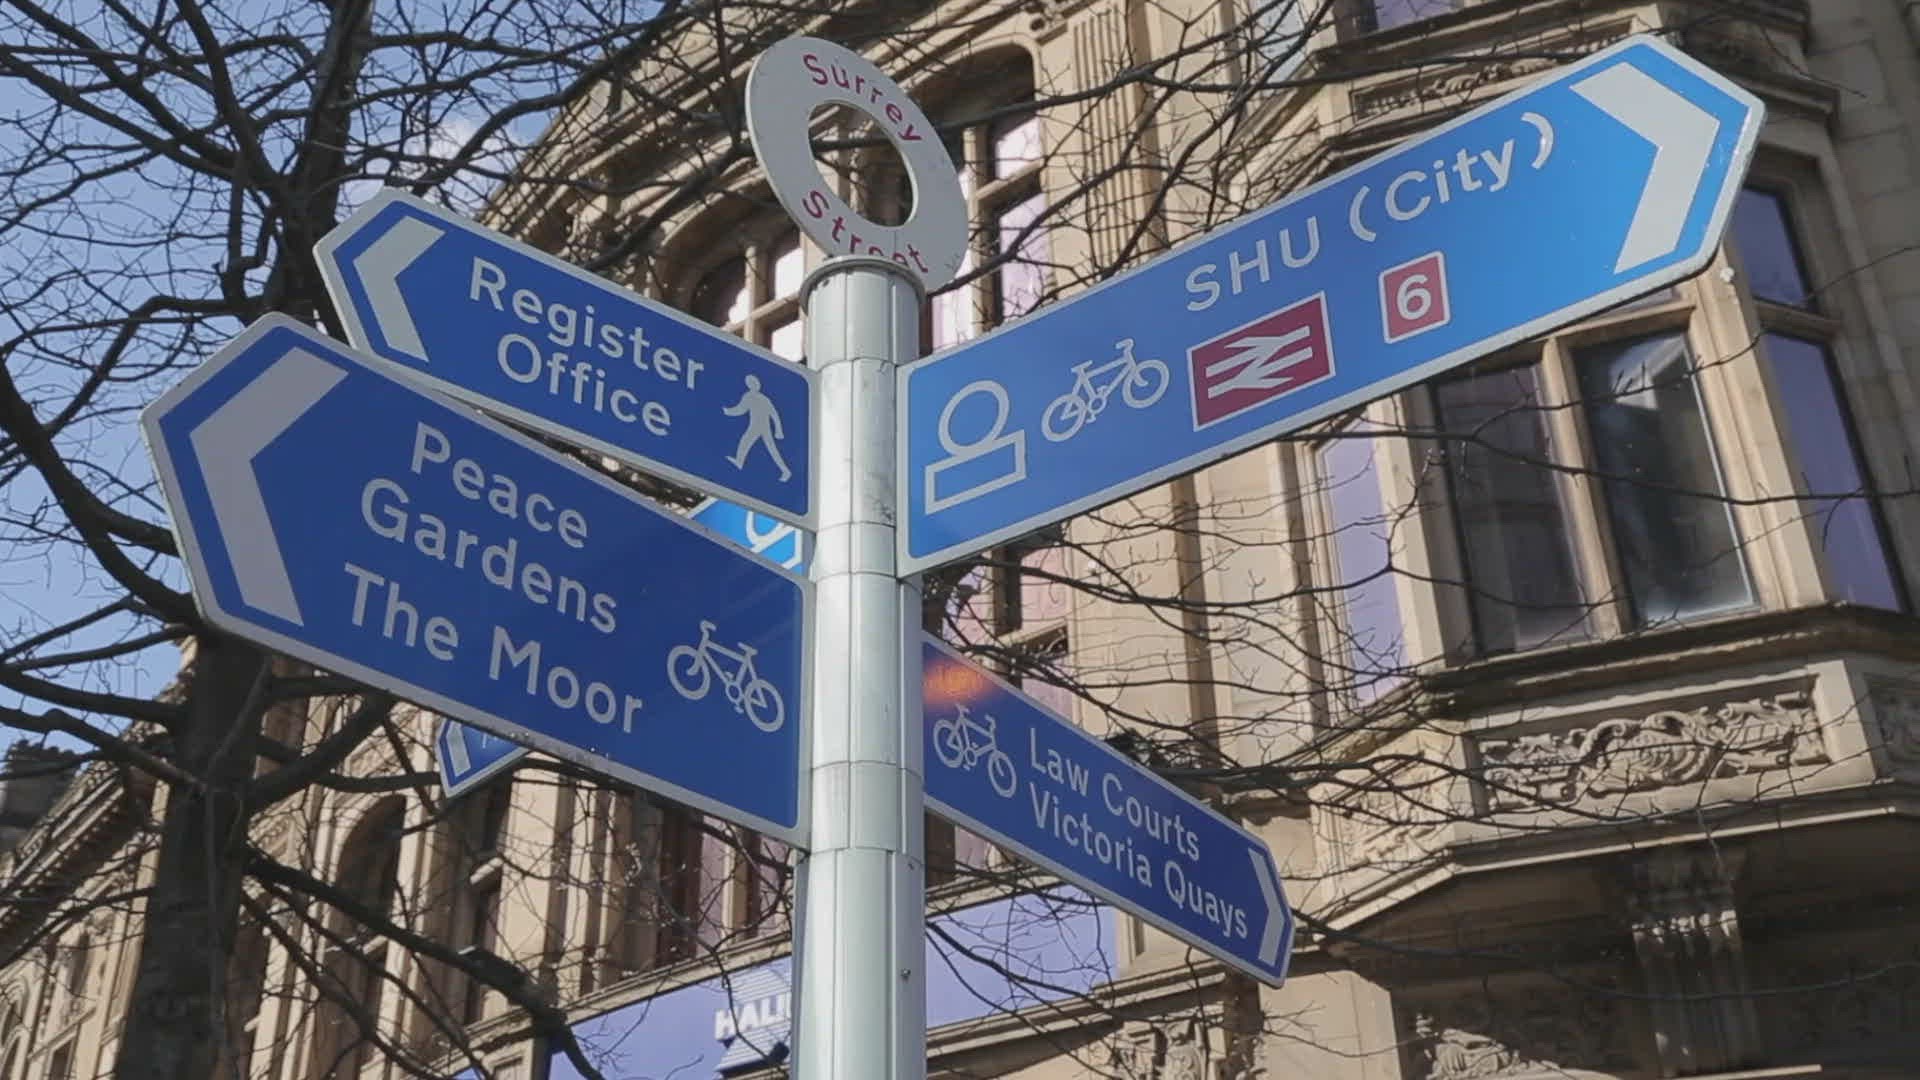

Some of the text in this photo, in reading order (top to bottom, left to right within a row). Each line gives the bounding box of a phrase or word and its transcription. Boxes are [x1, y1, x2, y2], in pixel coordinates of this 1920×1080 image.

[803, 54, 922, 142] Surrey
[1185, 111, 1554, 311] SHU (City)
[469, 255, 704, 391] Register
[1396, 273, 1432, 321] 6
[496, 333, 671, 436] Office
[410, 421, 588, 549] Peace
[361, 477, 617, 634] Gardens
[344, 562, 643, 734] The Moor
[1029, 727, 1201, 862] Law Courts
[1029, 782, 1248, 940] Victoria Quays
